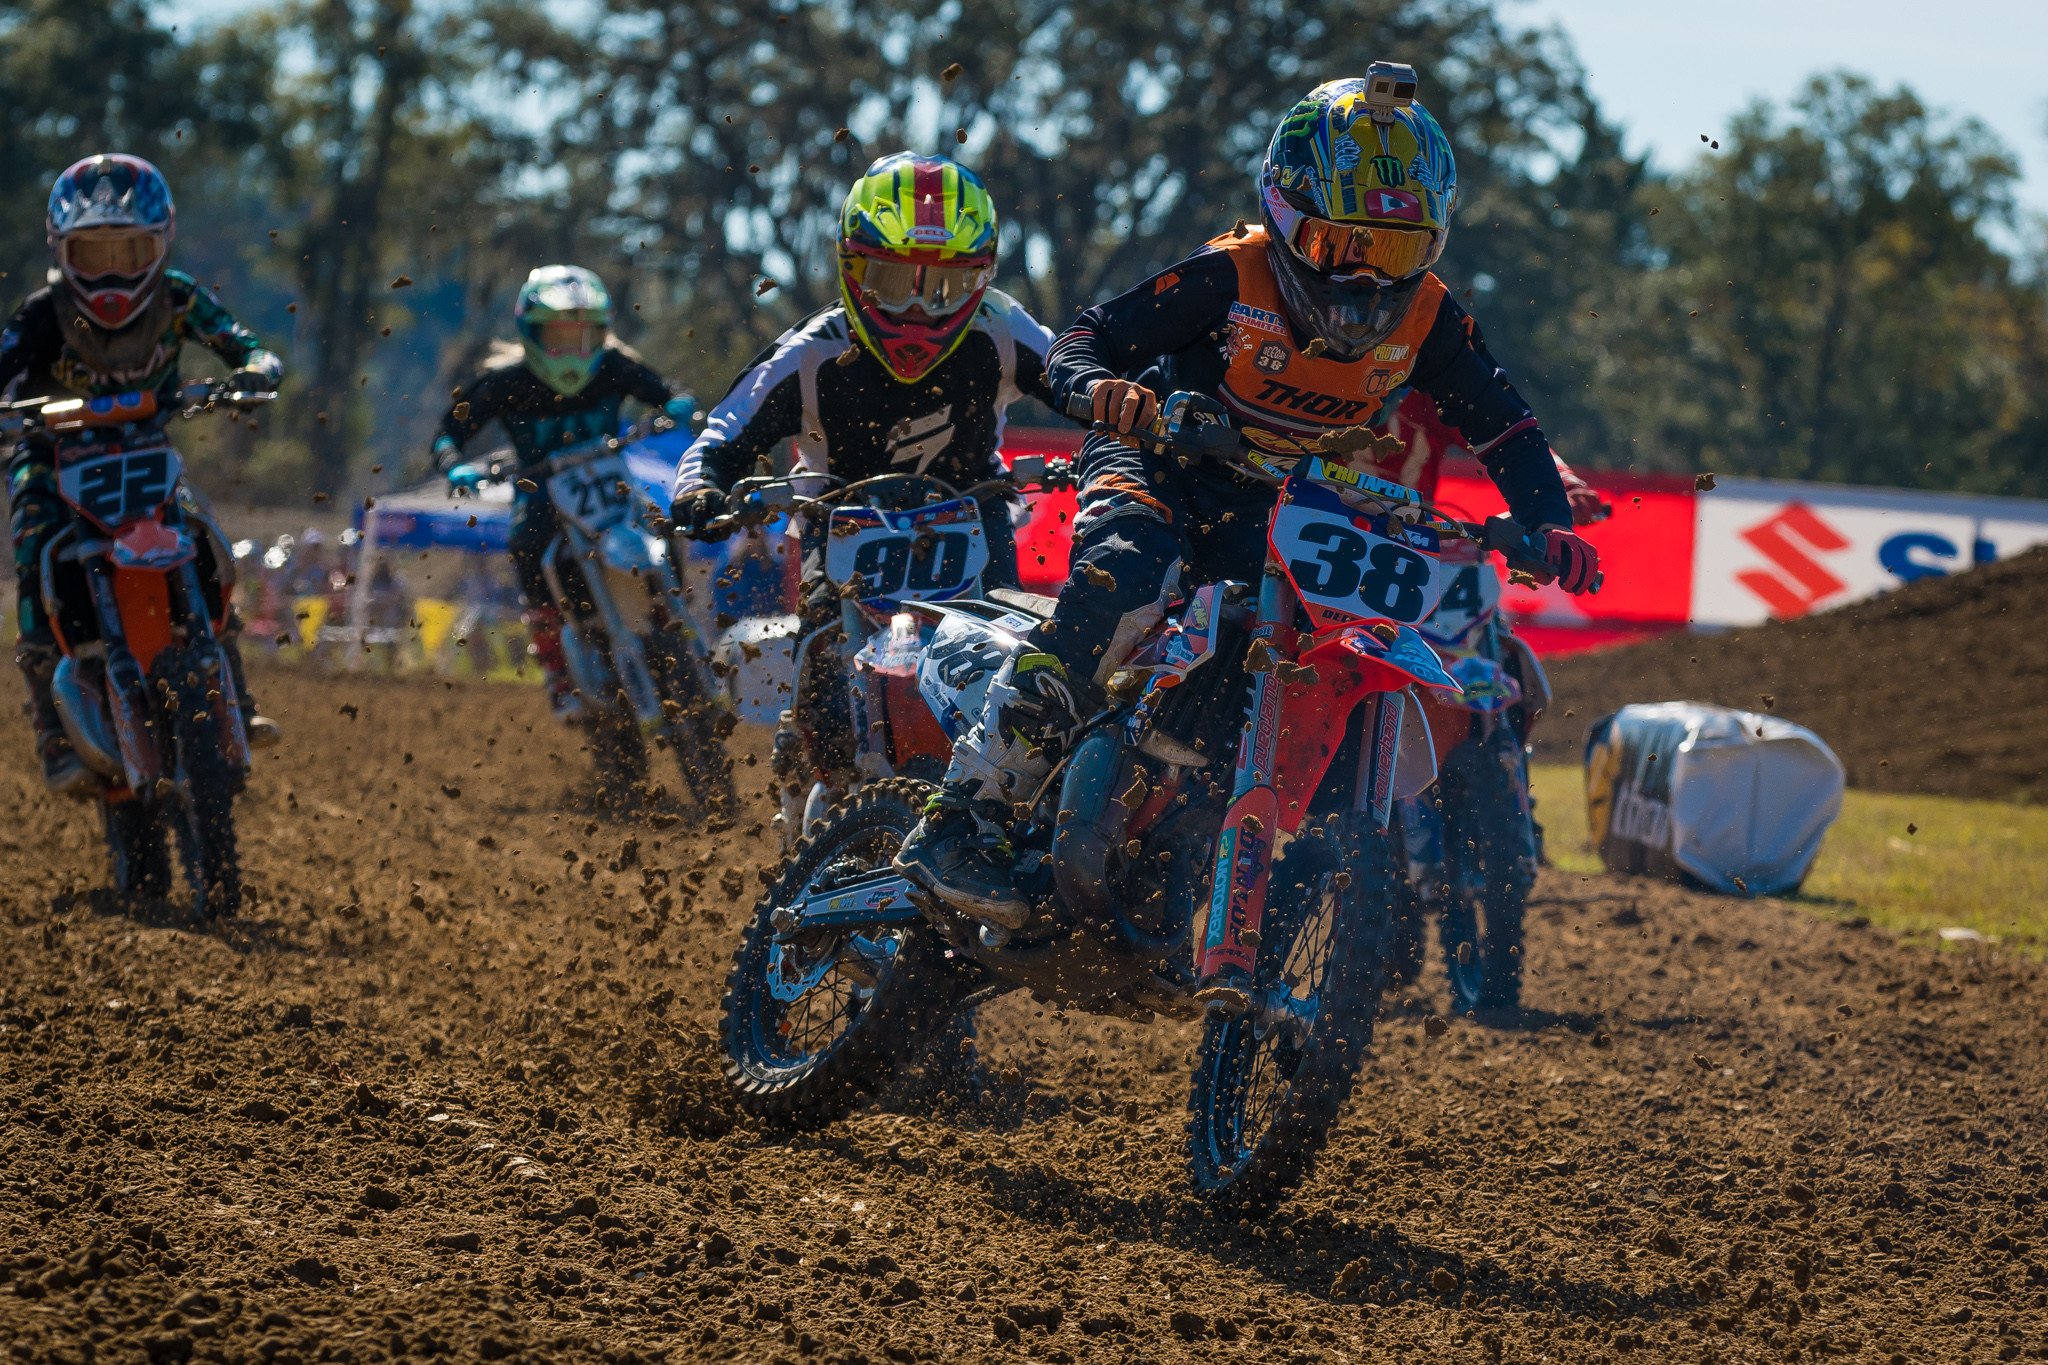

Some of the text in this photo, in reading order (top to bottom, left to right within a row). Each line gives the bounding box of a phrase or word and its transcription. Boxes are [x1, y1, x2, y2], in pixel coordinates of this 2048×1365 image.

[913, 229, 947, 237] BELL
[1229, 313, 1288, 335] UNLIMITED
[1230, 301, 1285, 327] PARTS
[1258, 356, 1284, 371] 38
[1255, 379, 1369, 420] THOR
[79, 451, 167, 518] 22
[1325, 461, 1411, 499] PROTAPER
[854, 532, 969, 598] 90
[1287, 521, 1431, 624] 38
[1254, 666, 1282, 776] owerband
[1208, 857, 1231, 942] MOTOREX
